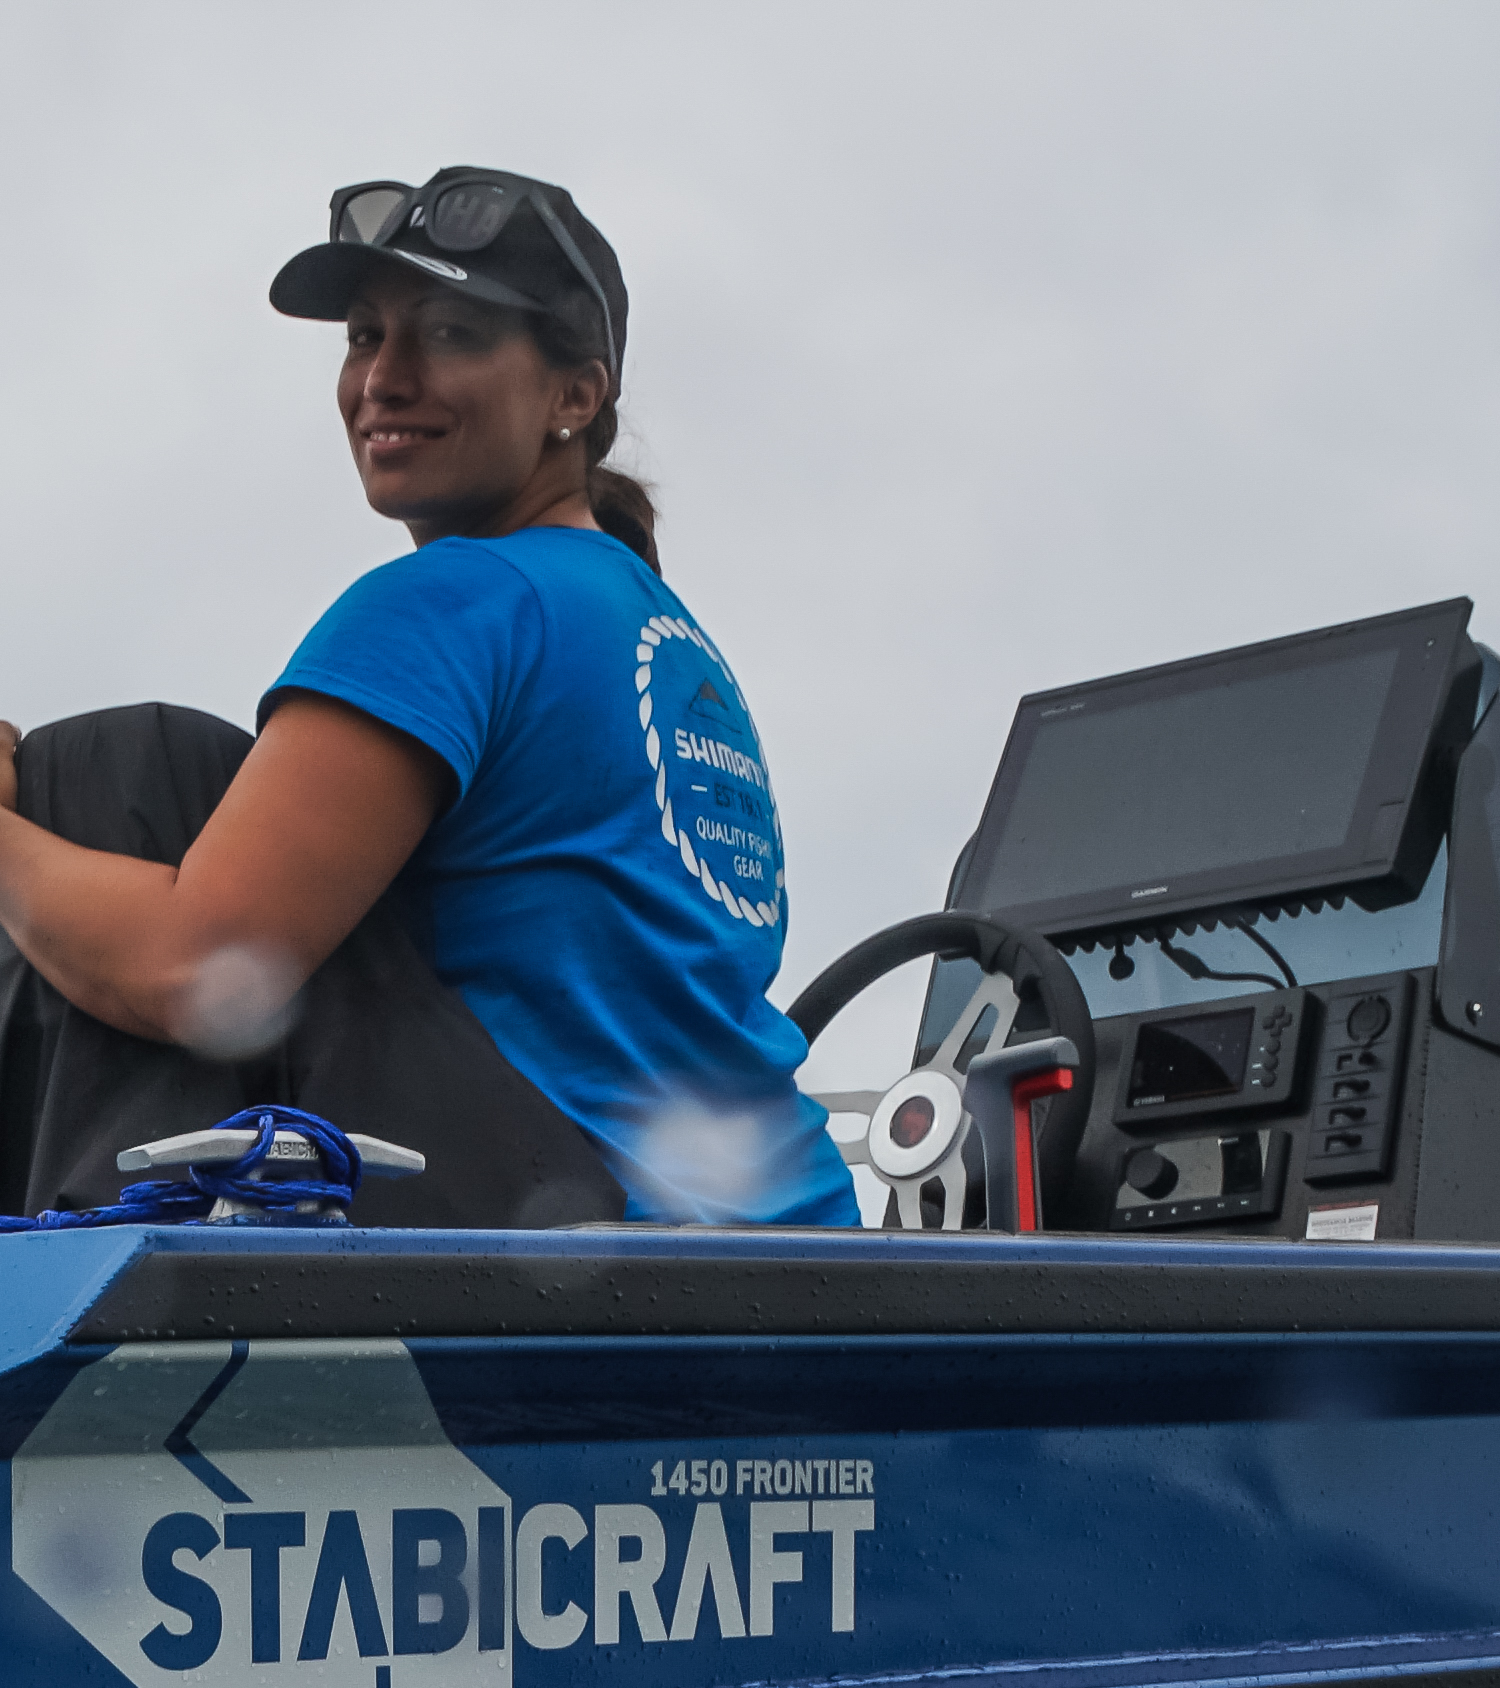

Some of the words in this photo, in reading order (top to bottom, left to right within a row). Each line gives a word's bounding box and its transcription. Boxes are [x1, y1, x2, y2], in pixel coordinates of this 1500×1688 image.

[696, 816, 746, 849] QUALITY
[733, 855, 763, 880] GEAR
[651, 1459, 728, 1496] 1450
[736, 1458, 875, 1496] FRONTIER
[139, 1500, 875, 1671] STABICRAFT
